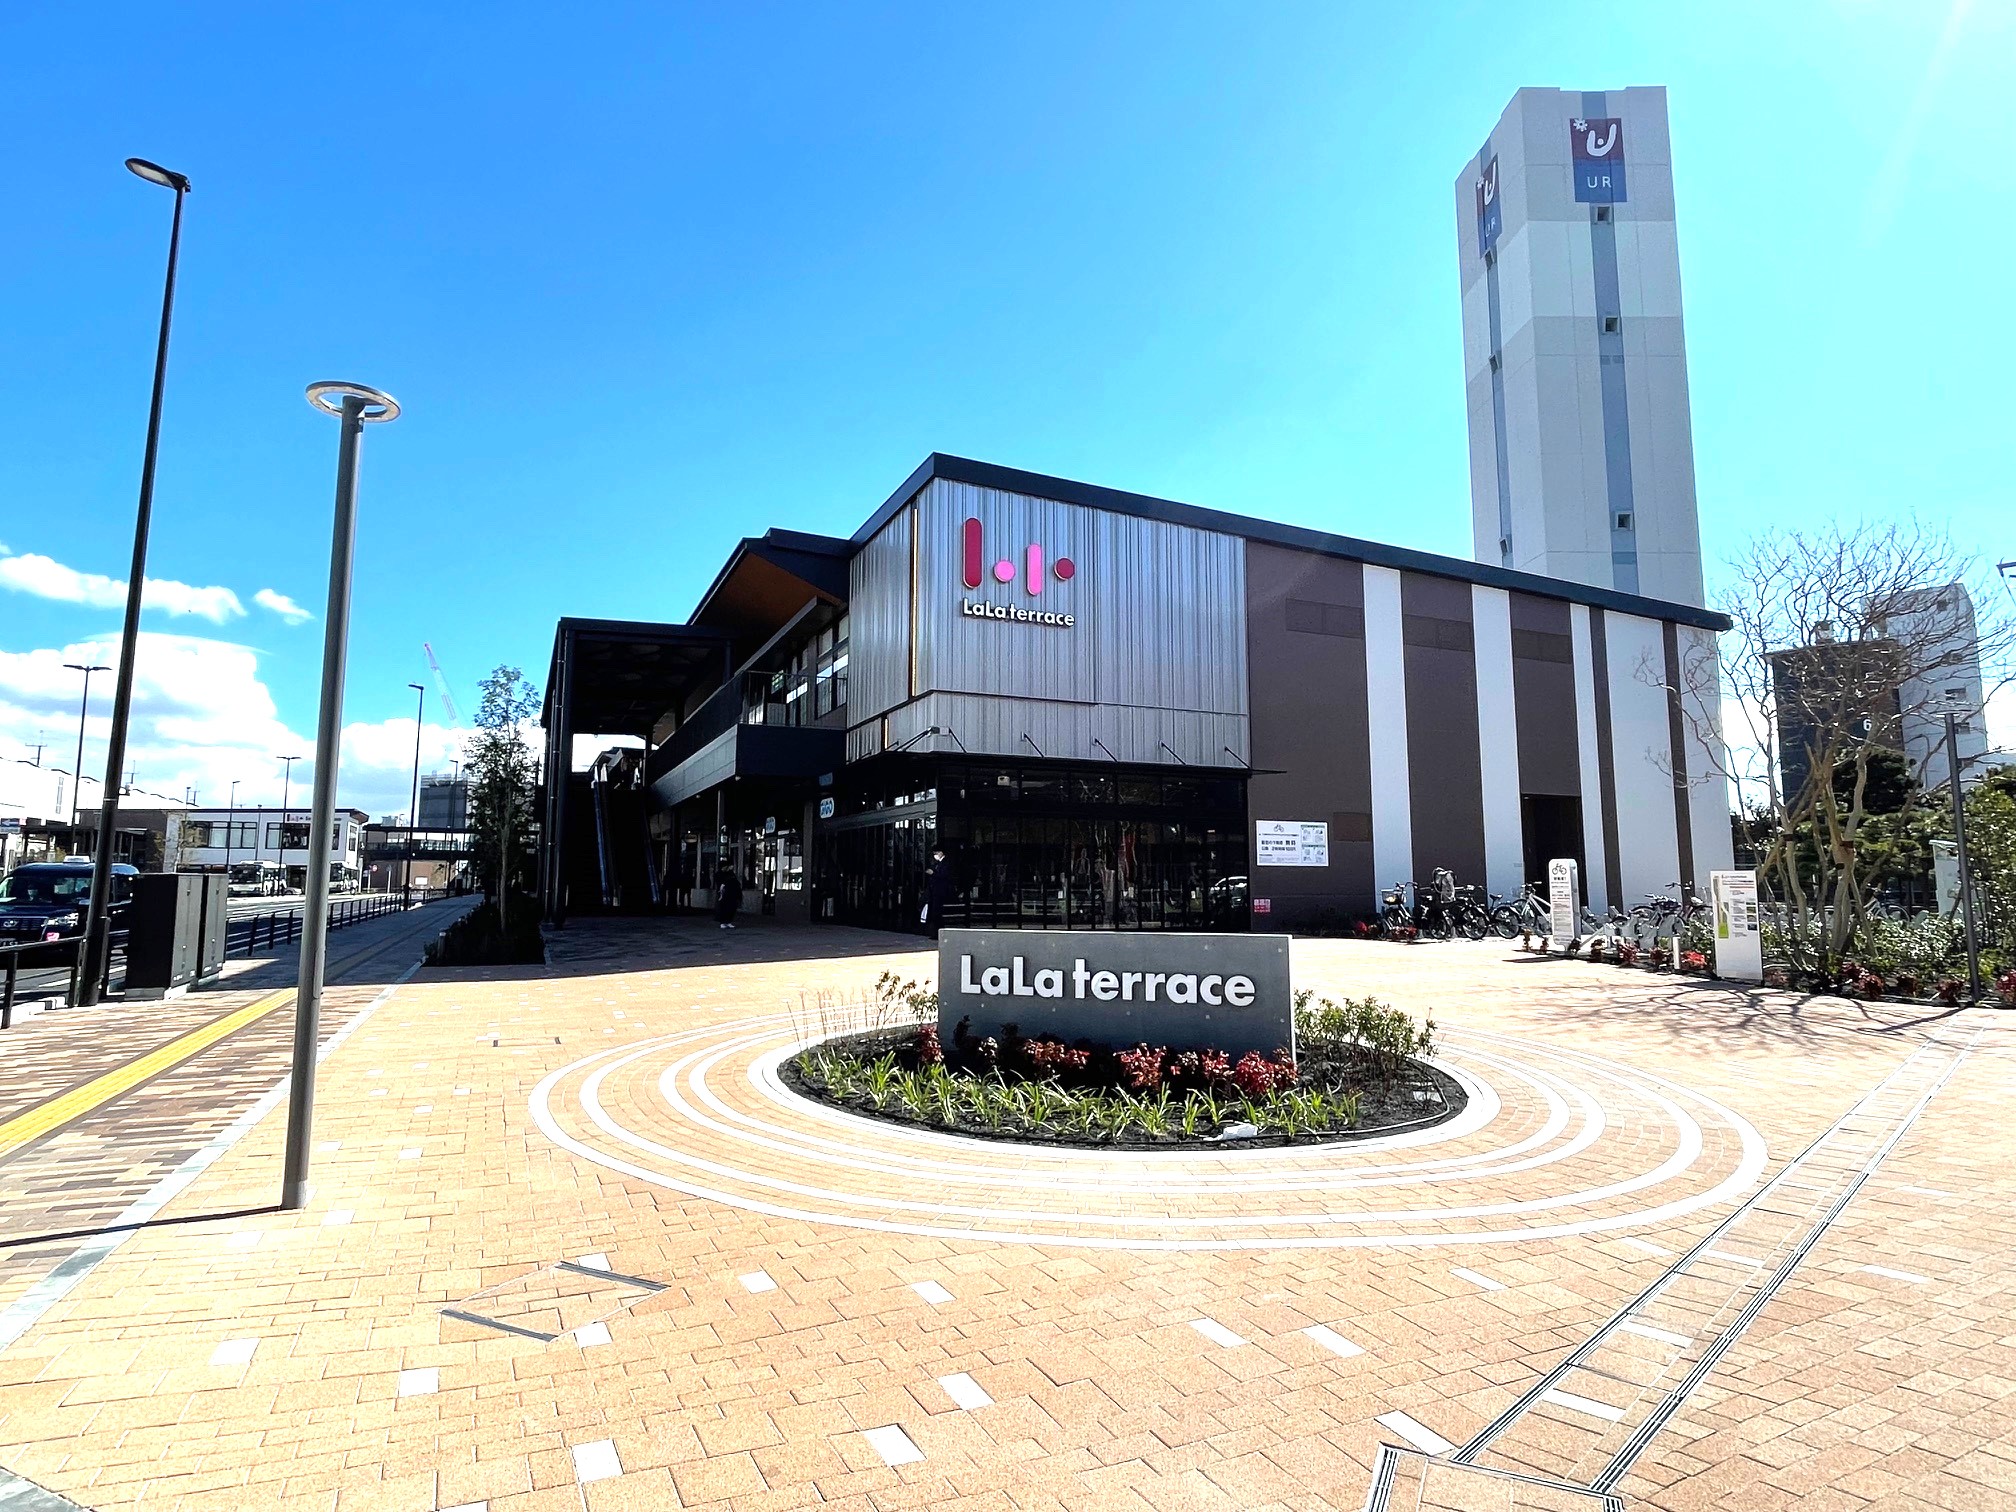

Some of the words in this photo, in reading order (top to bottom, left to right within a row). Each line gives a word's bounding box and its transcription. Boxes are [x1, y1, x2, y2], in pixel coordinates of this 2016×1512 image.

[1587, 176, 1612, 188] UR
[963, 597, 1006, 619] LaLa
[1009, 603, 1075, 627] terrace
[960, 954, 1063, 998] LaLa
[1072, 958, 1256, 1007] terrace
